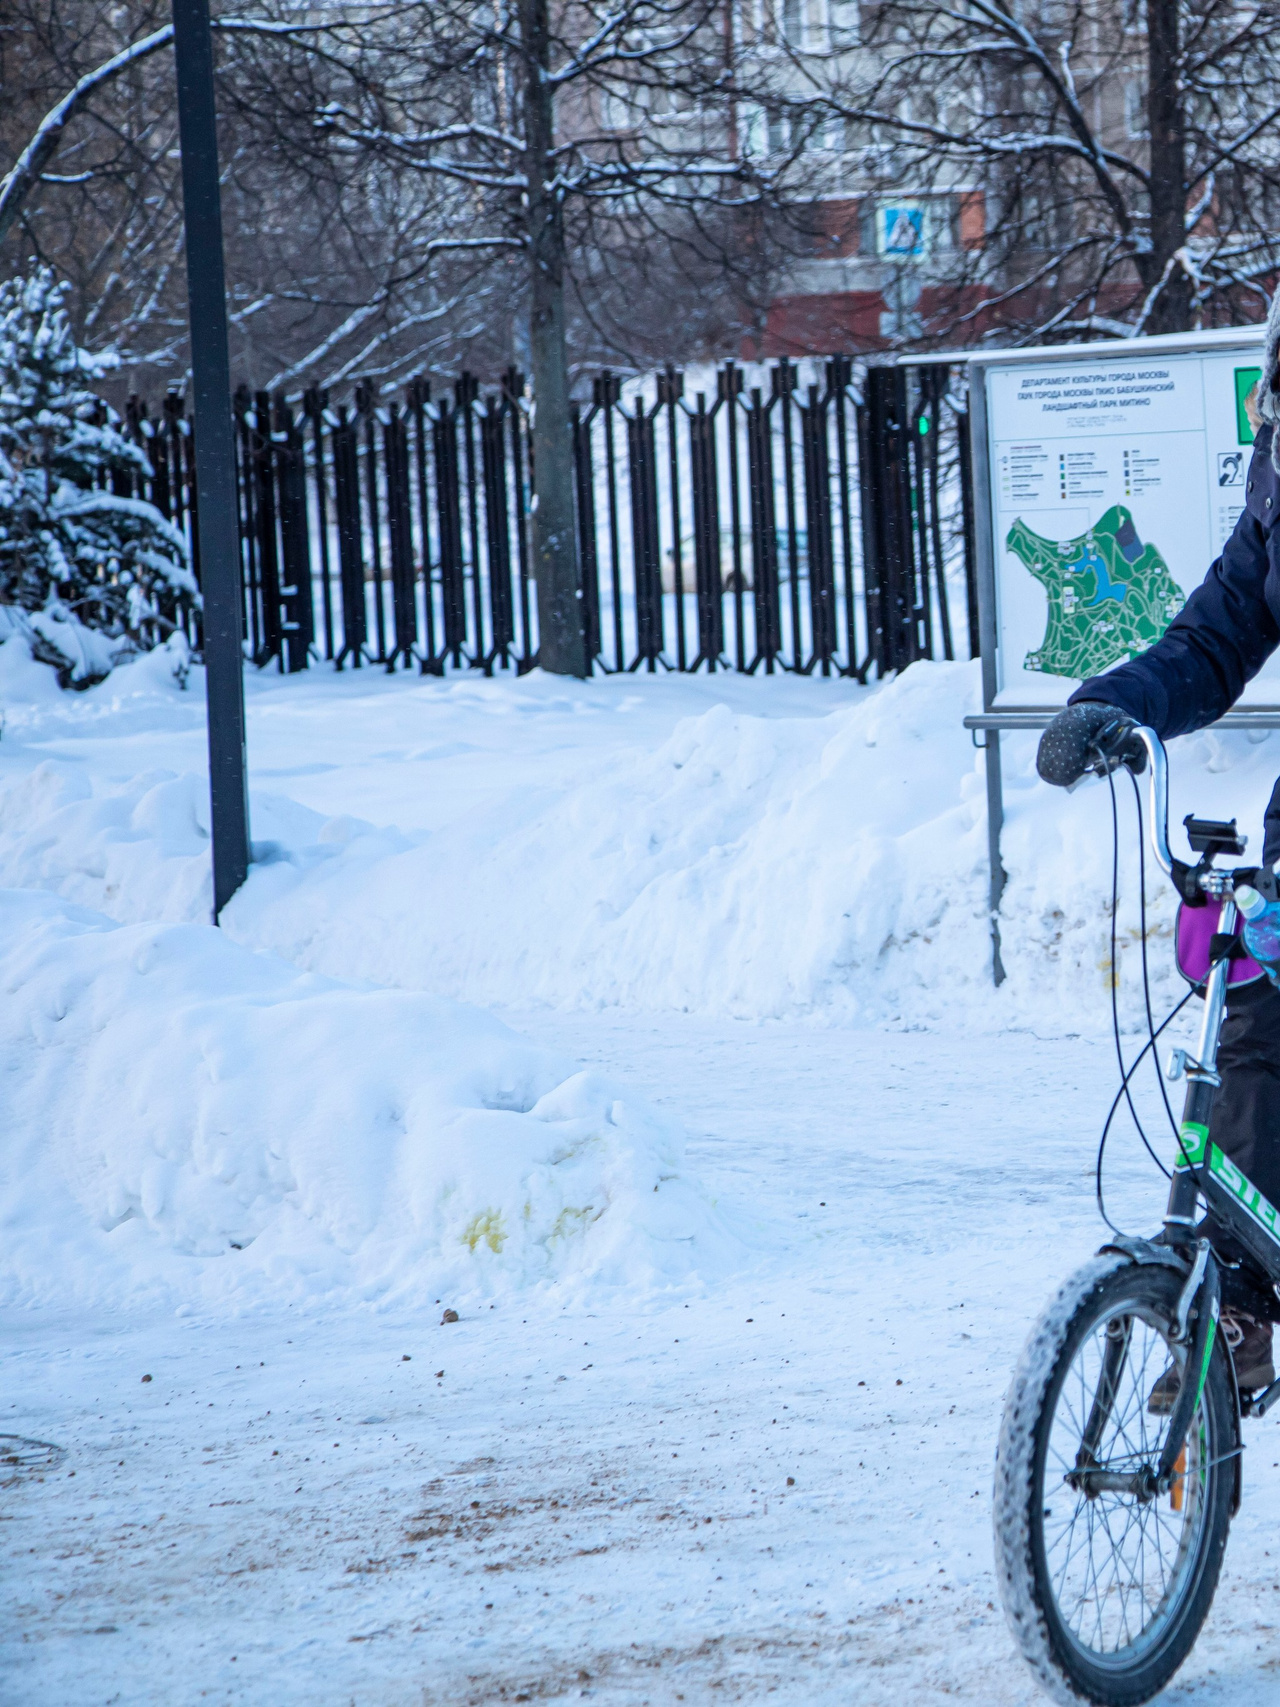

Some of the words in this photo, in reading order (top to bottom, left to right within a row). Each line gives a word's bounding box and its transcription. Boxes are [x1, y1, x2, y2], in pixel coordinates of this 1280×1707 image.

[1021, 376, 1071, 388] ДЕПАРТАМЕНТ
[1072, 374, 1107, 385] КУЛЬТУРЫ
[1108, 372, 1136, 382] ГОРОДА
[1138, 370, 1170, 380] МОСКВЫ
[1017, 391, 1033, 400] ГАУК
[1035, 389, 1061, 400] ГОРОДА
[1063, 387, 1094, 397] МОСКВЫ
[1117, 381, 1175, 395] БАБУШКИНСКИЙ
[1042, 400, 1098, 412] ЛАНДШАФТНЫЙ
[1100, 399, 1118, 408] ПАРК
[1119, 398, 1151, 408] МИТИНО
